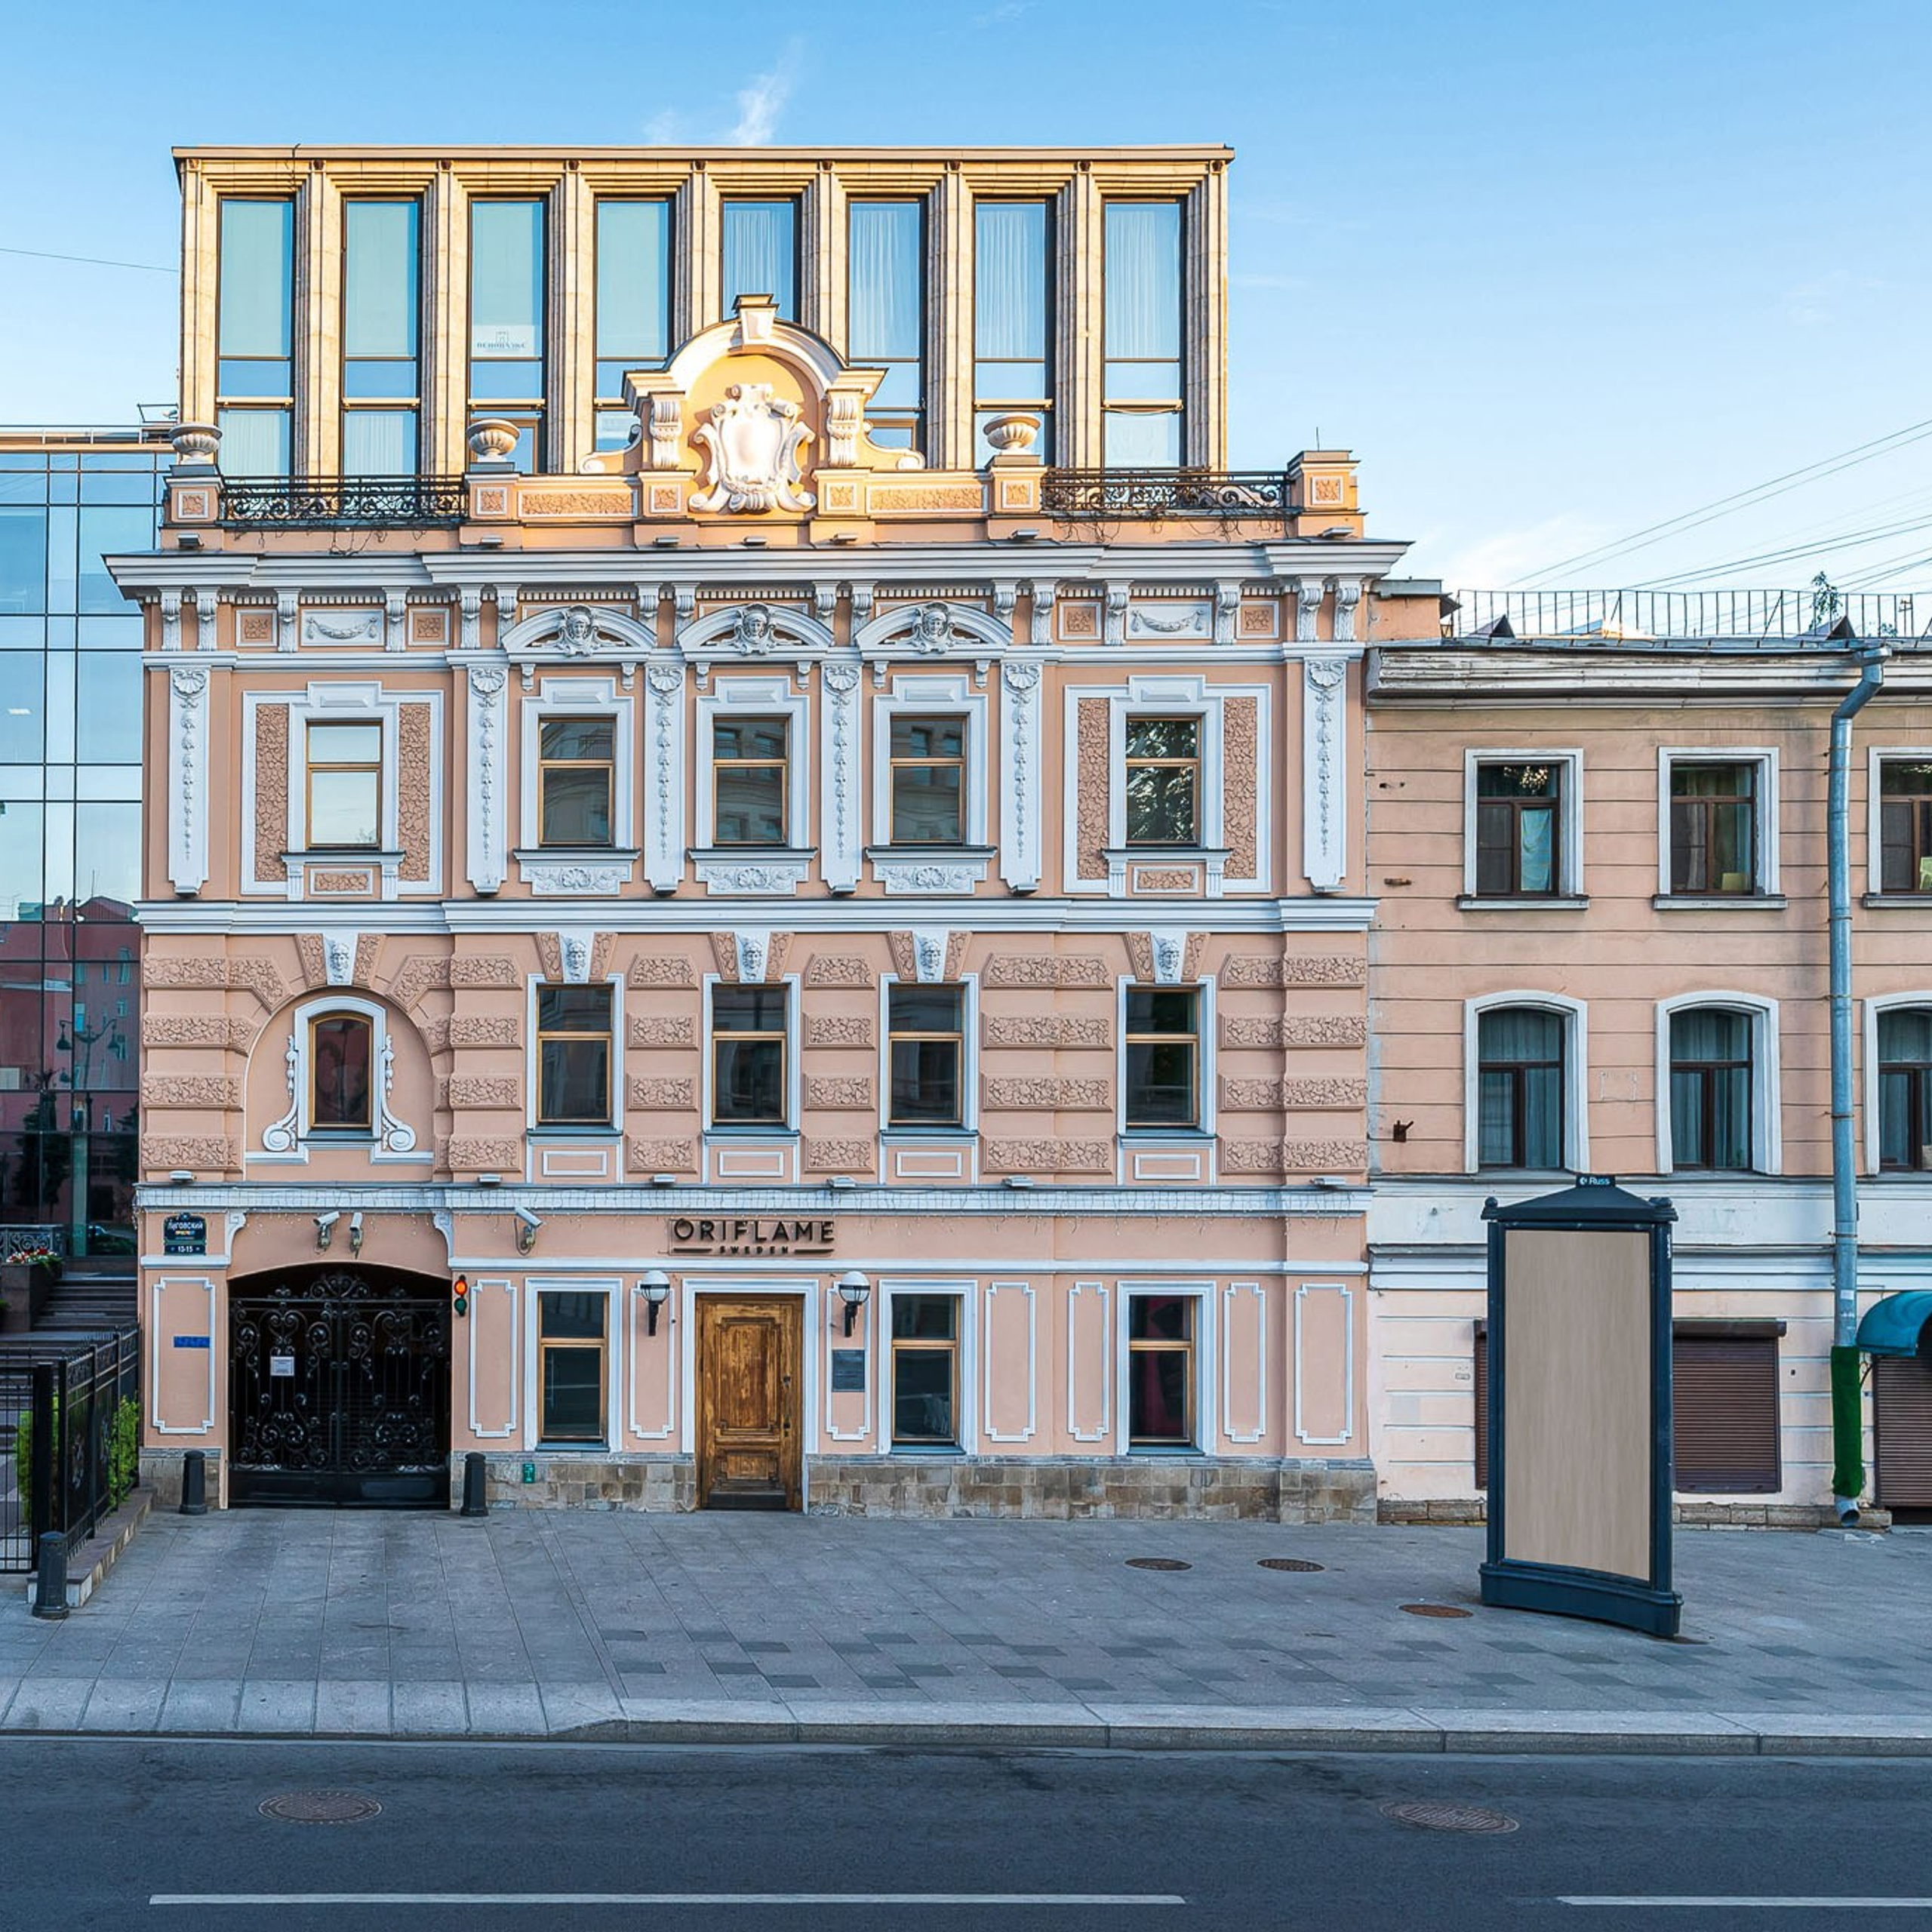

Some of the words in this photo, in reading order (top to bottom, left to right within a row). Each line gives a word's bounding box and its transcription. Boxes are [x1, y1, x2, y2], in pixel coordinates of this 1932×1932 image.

[1588, 1177, 1611, 1186] Russ
[674, 1218, 835, 1243] ORIFLAME
[719, 1246, 789, 1254] SWEDEN
